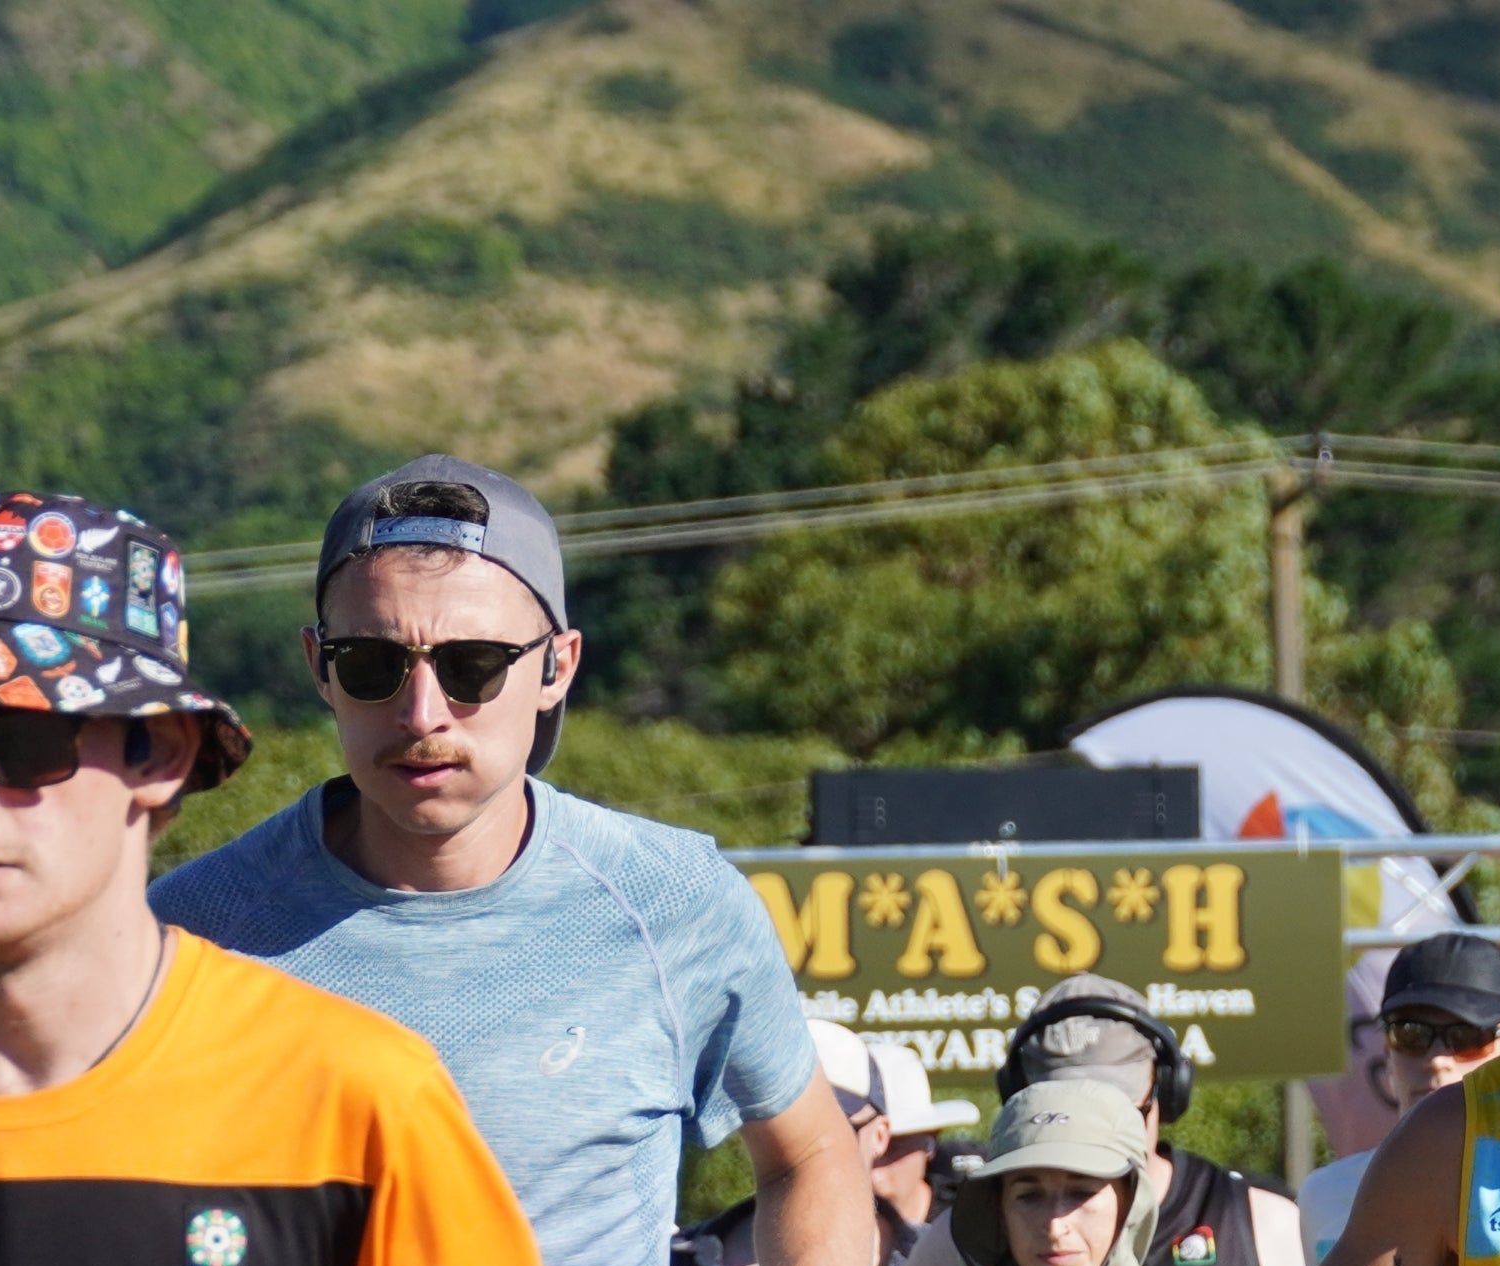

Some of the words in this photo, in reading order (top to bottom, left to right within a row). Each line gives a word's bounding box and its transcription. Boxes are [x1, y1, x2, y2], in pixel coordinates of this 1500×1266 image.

[798, 989, 859, 1023] bile
[862, 987, 1011, 1022] Athlete's
[1146, 983, 1255, 1018] Haven
[858, 1028, 1018, 1072] KYAR
